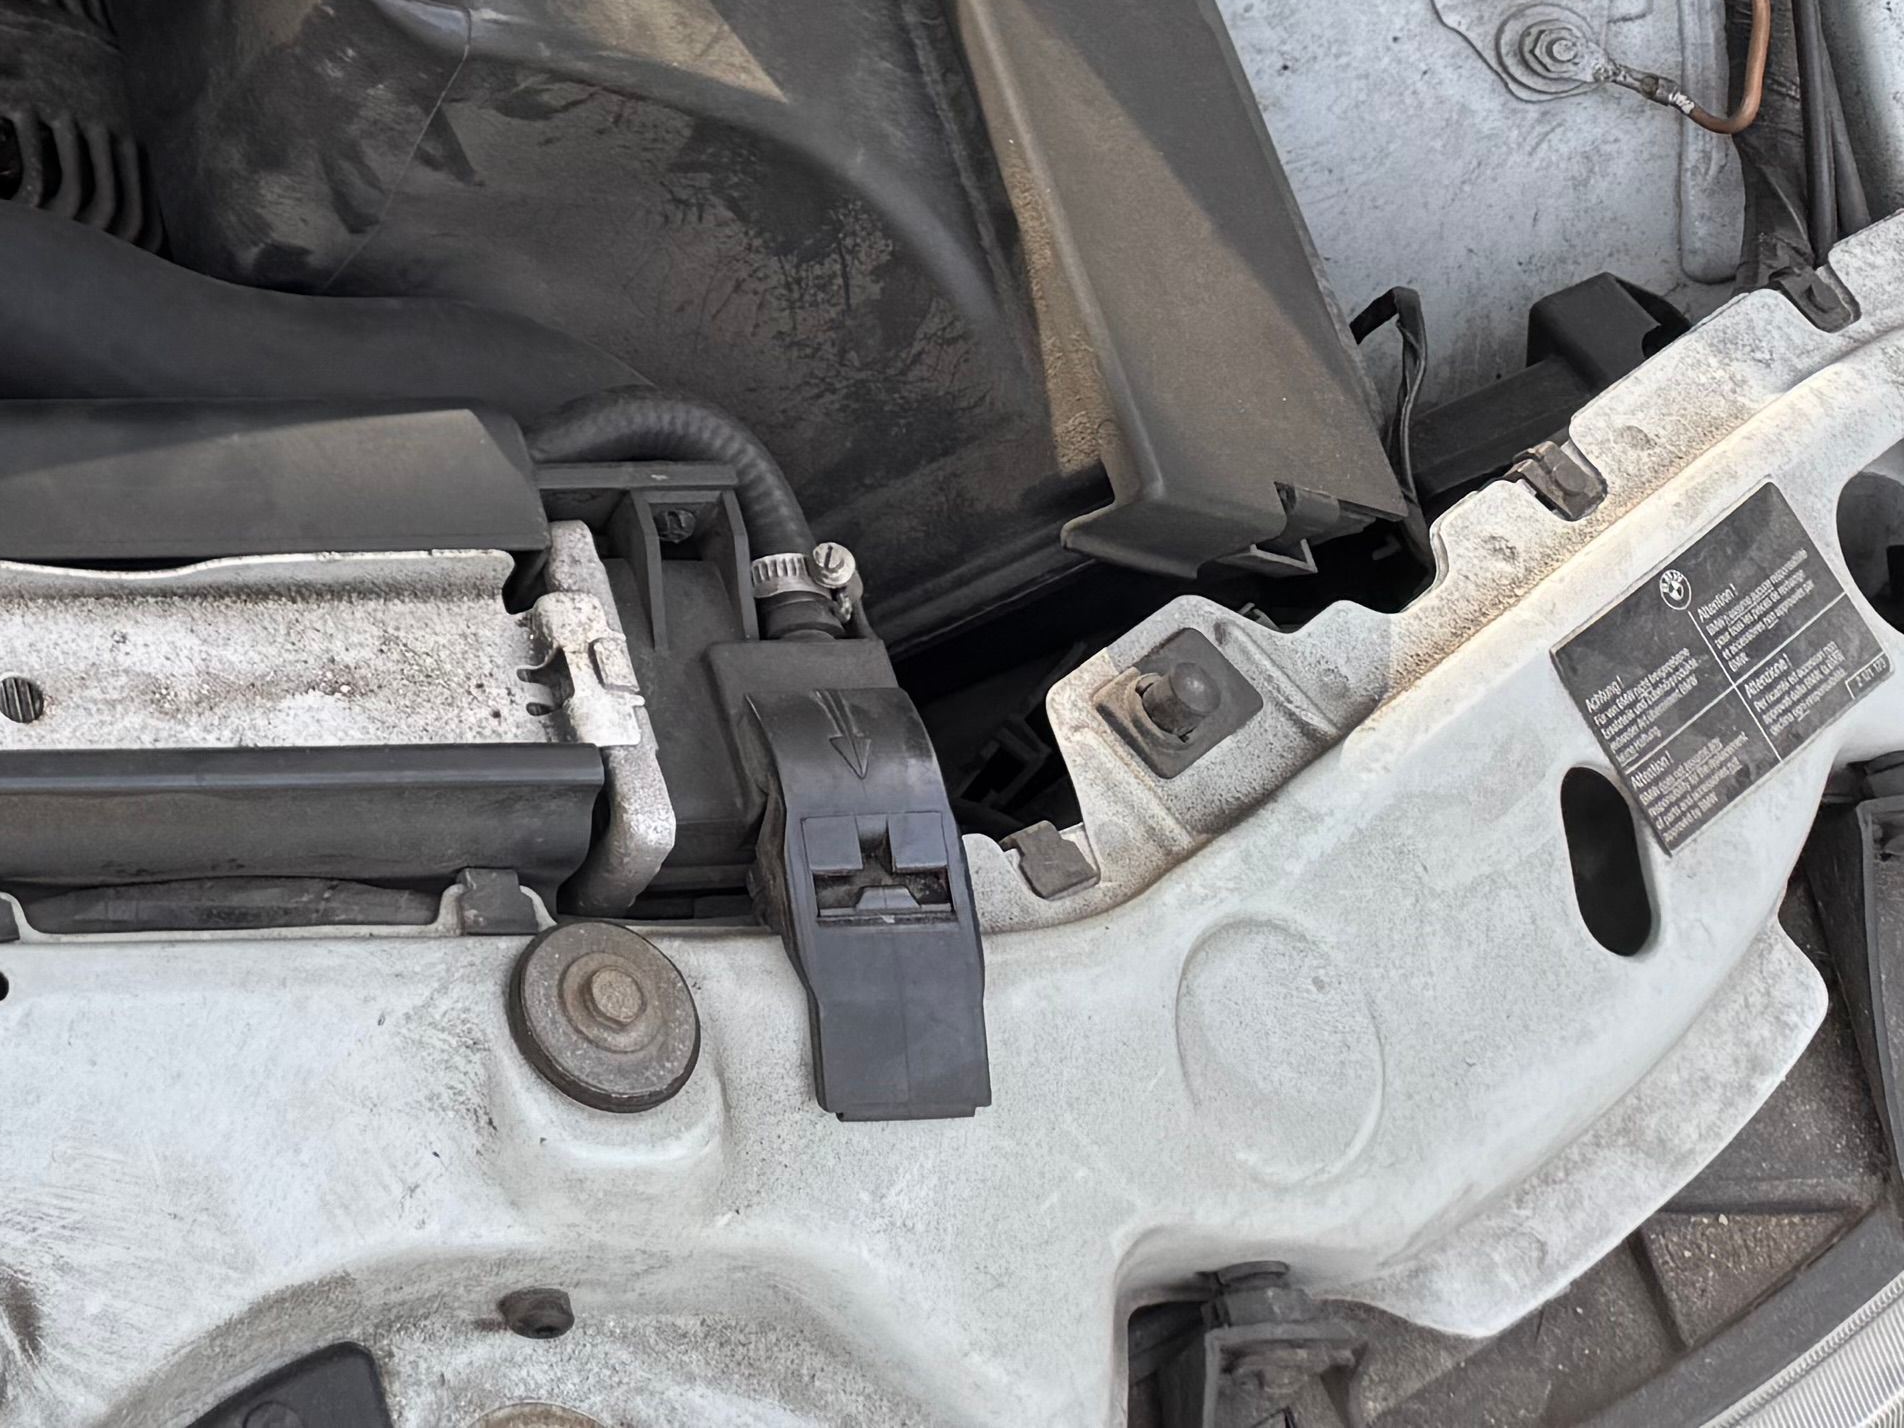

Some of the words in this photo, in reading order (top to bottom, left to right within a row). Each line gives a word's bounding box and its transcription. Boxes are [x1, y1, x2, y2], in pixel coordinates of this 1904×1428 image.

[1695, 585, 1735, 623] Attention
[1583, 677, 1622, 716] Achtung
[1742, 654, 1789, 699] Attenzione
[1628, 750, 1670, 793] Attention
